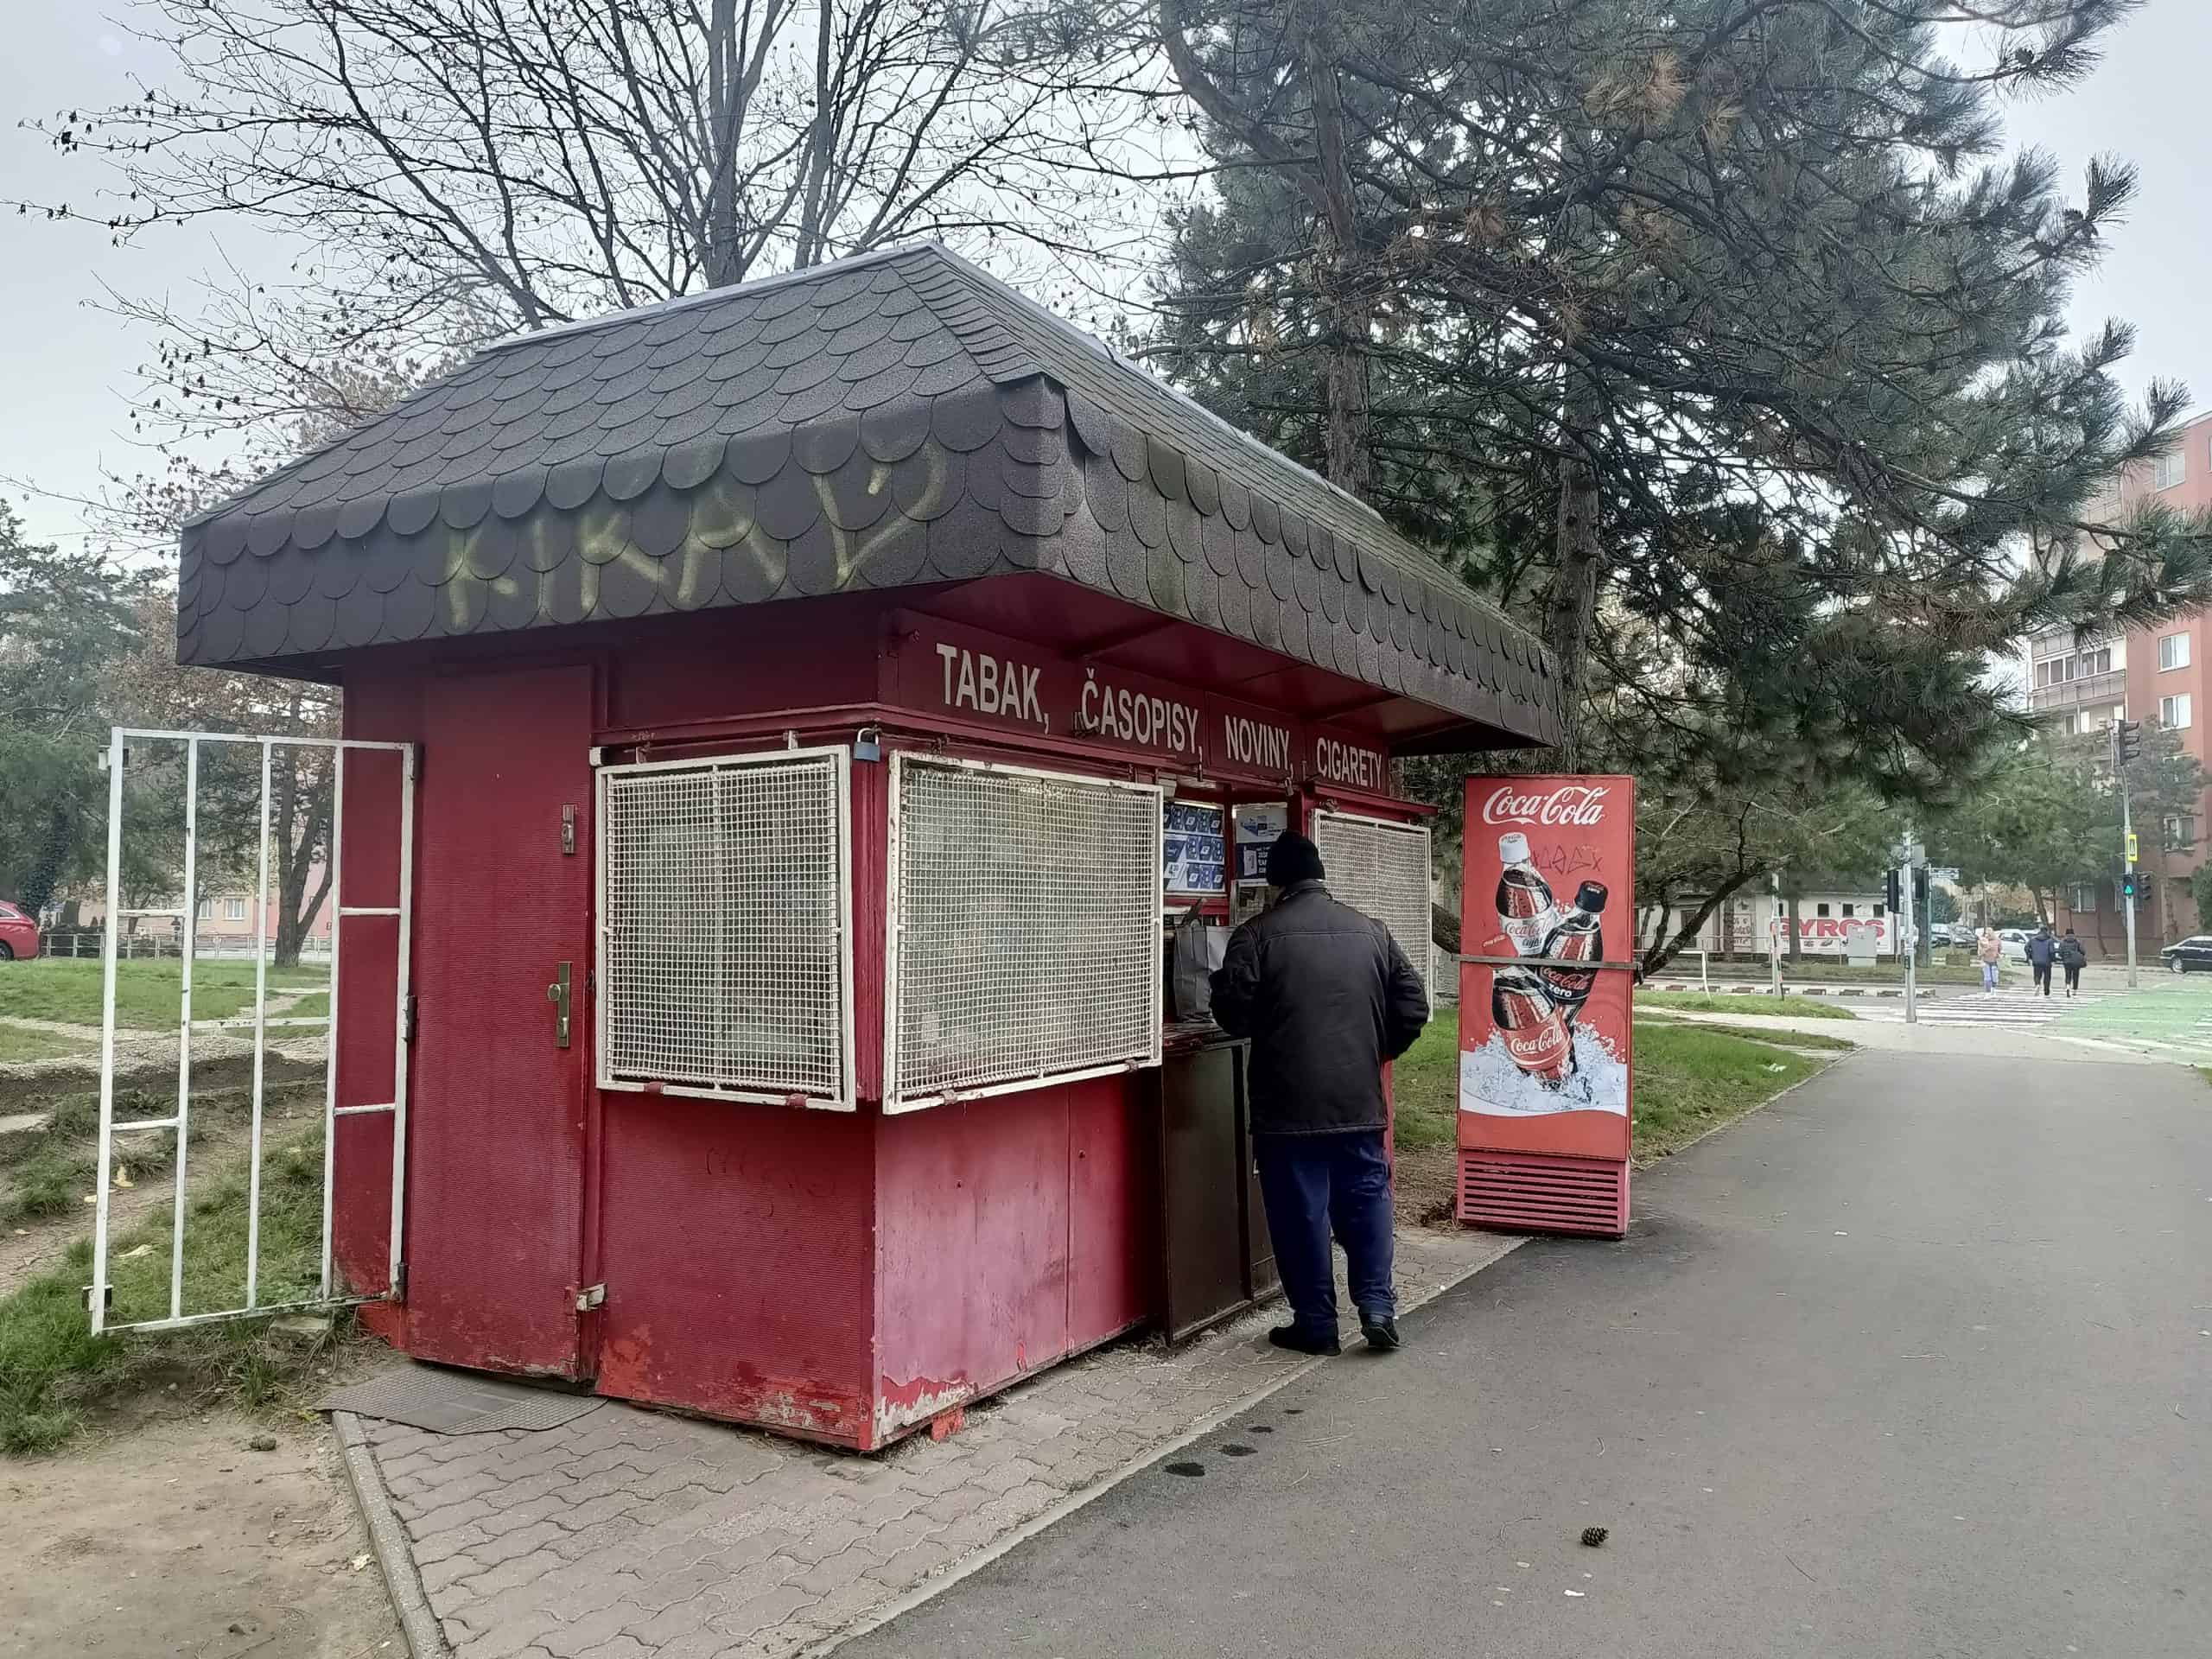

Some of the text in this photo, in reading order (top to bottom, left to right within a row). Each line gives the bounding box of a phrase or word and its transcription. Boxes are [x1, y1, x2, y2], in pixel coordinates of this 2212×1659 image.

[936, 643, 1382, 789] TABAK, ČASOPISY, NOVINY, CIGARETY
[1483, 786, 1611, 825] Coca-Cola
[1548, 983, 1573, 997] zero
[1511, 1026, 1565, 1056] Coca-Cola
